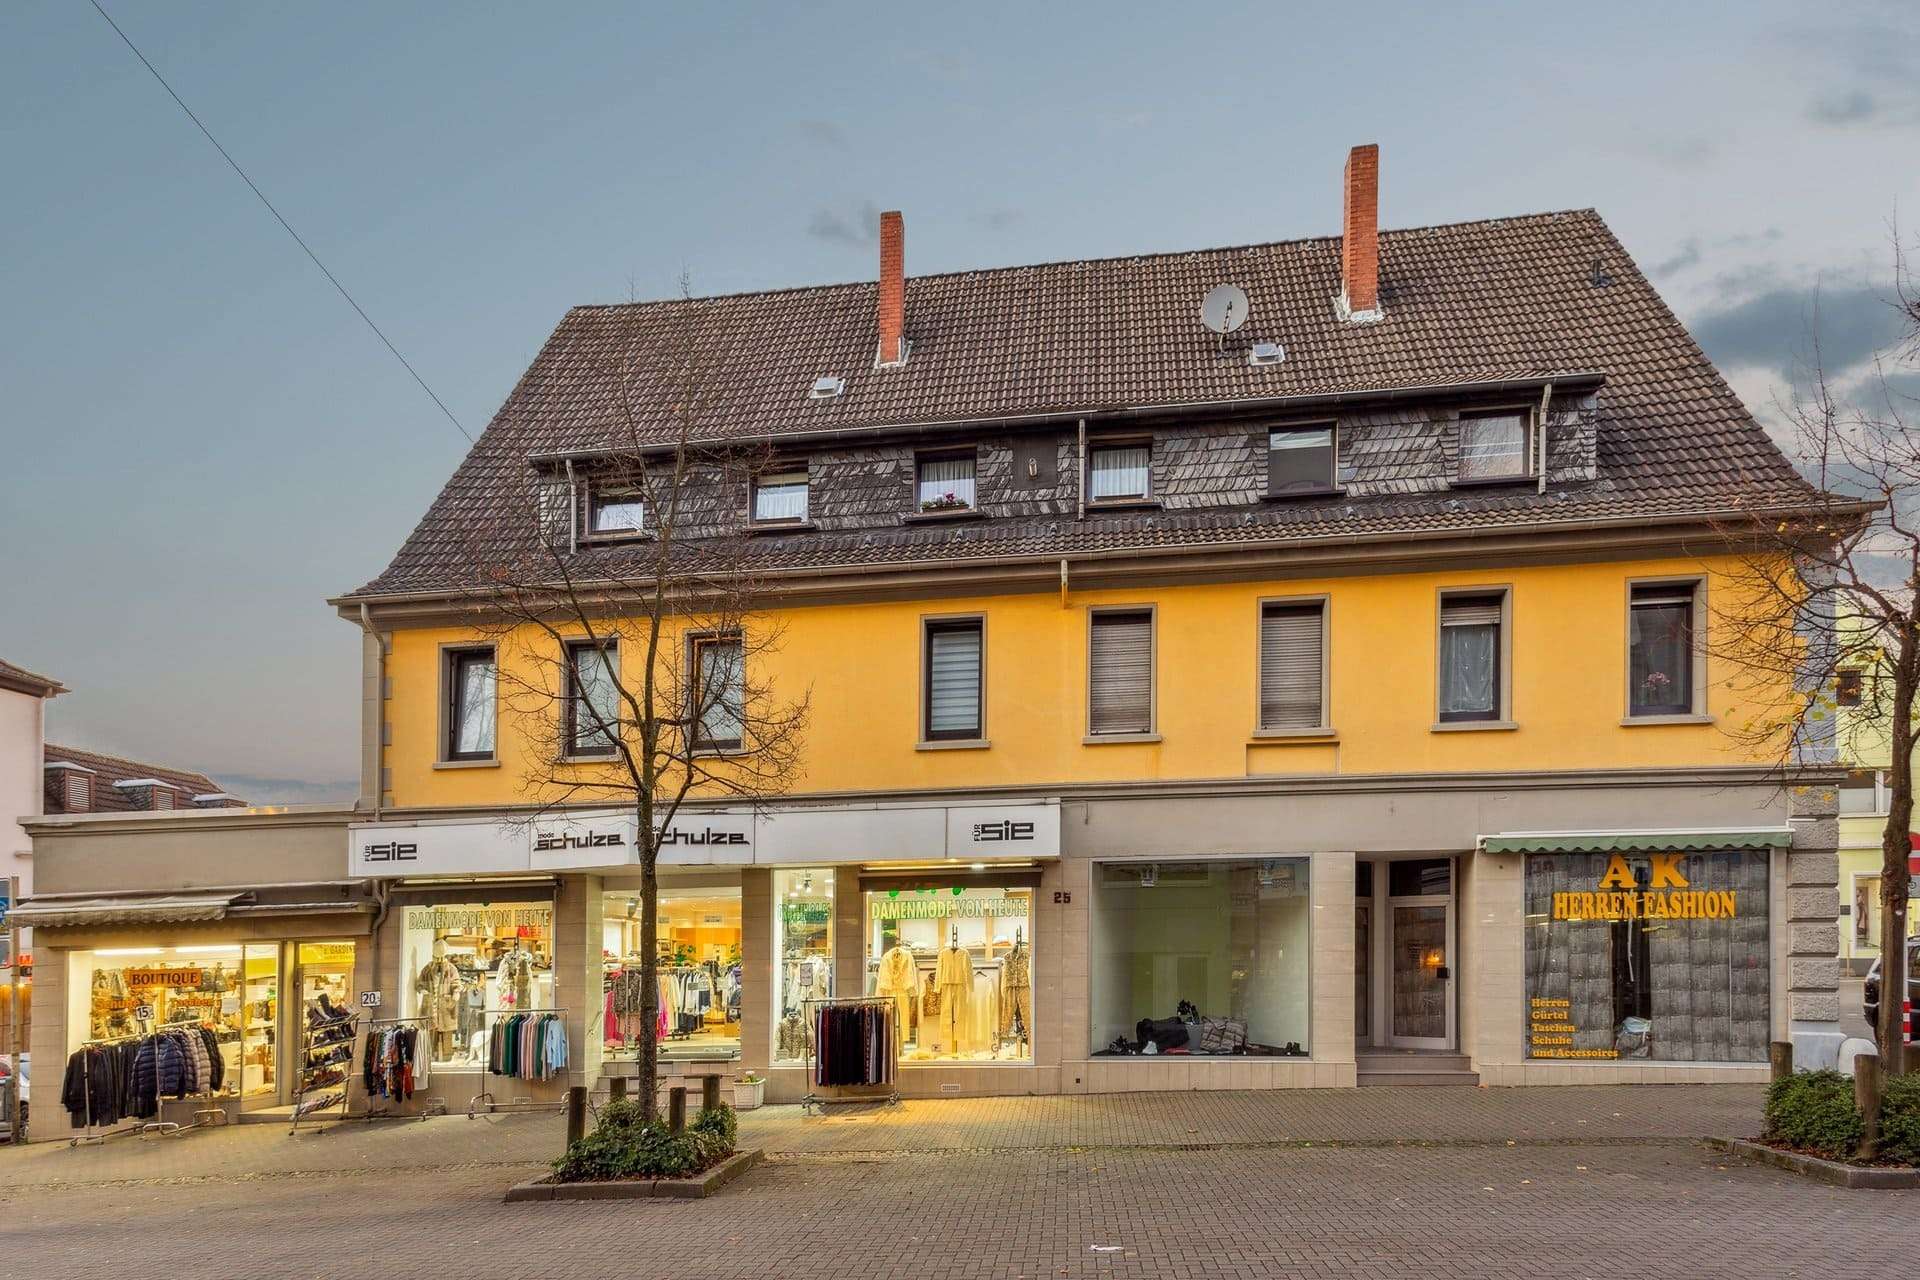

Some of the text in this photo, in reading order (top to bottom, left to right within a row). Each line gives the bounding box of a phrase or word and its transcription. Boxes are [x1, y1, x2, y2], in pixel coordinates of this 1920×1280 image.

[533, 830, 626, 851] schulze
[634, 827, 750, 846] chulze
[1599, 852, 1690, 889] A K
[1053, 891, 1071, 903] 25
[871, 898, 1028, 920] DAMENMODE VON HEUTE
[1553, 890, 1736, 920] HERREN FASHION
[409, 908, 550, 930] DAMENMODE VON HEUTE
[132, 972, 198, 986] BOUTIQUE
[1532, 998, 1570, 1008] Herren
[1532, 1010, 1568, 1020] Gürtel
[1532, 1023, 1576, 1032] Taschen
[1532, 1036, 1573, 1045] Schuhe
[1532, 1048, 1619, 1058] und Accessoires
